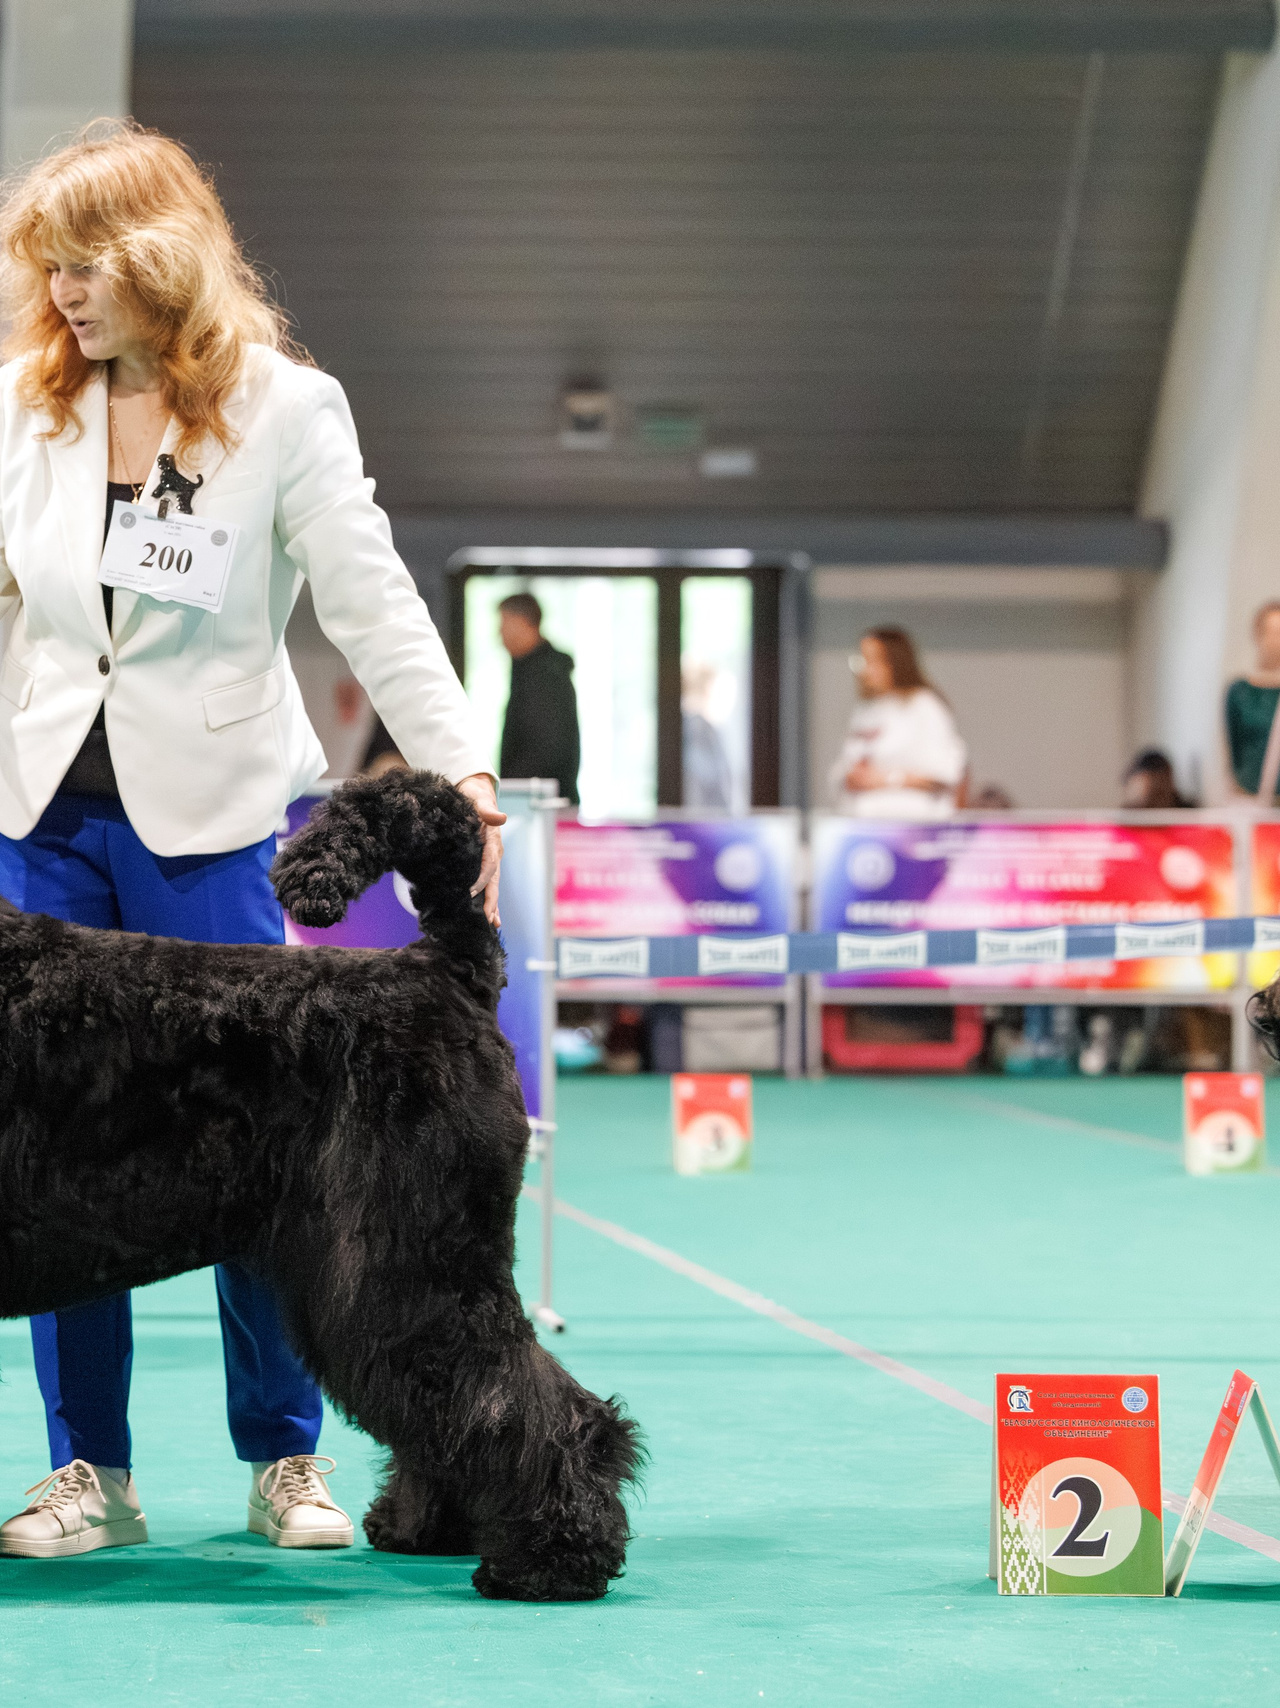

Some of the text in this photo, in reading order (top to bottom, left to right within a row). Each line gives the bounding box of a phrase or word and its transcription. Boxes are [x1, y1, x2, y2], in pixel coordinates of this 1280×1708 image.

[138, 542, 193, 574] 200
[1001, 1418, 1155, 1428] "БЕЛОРУССКОЕ КИНОЛОГИЧЕСКОЕ
[1044, 1429, 1112, 1438] ОБЪЕДИНЕНИЕ"
[1051, 1475, 1111, 1557] 2
